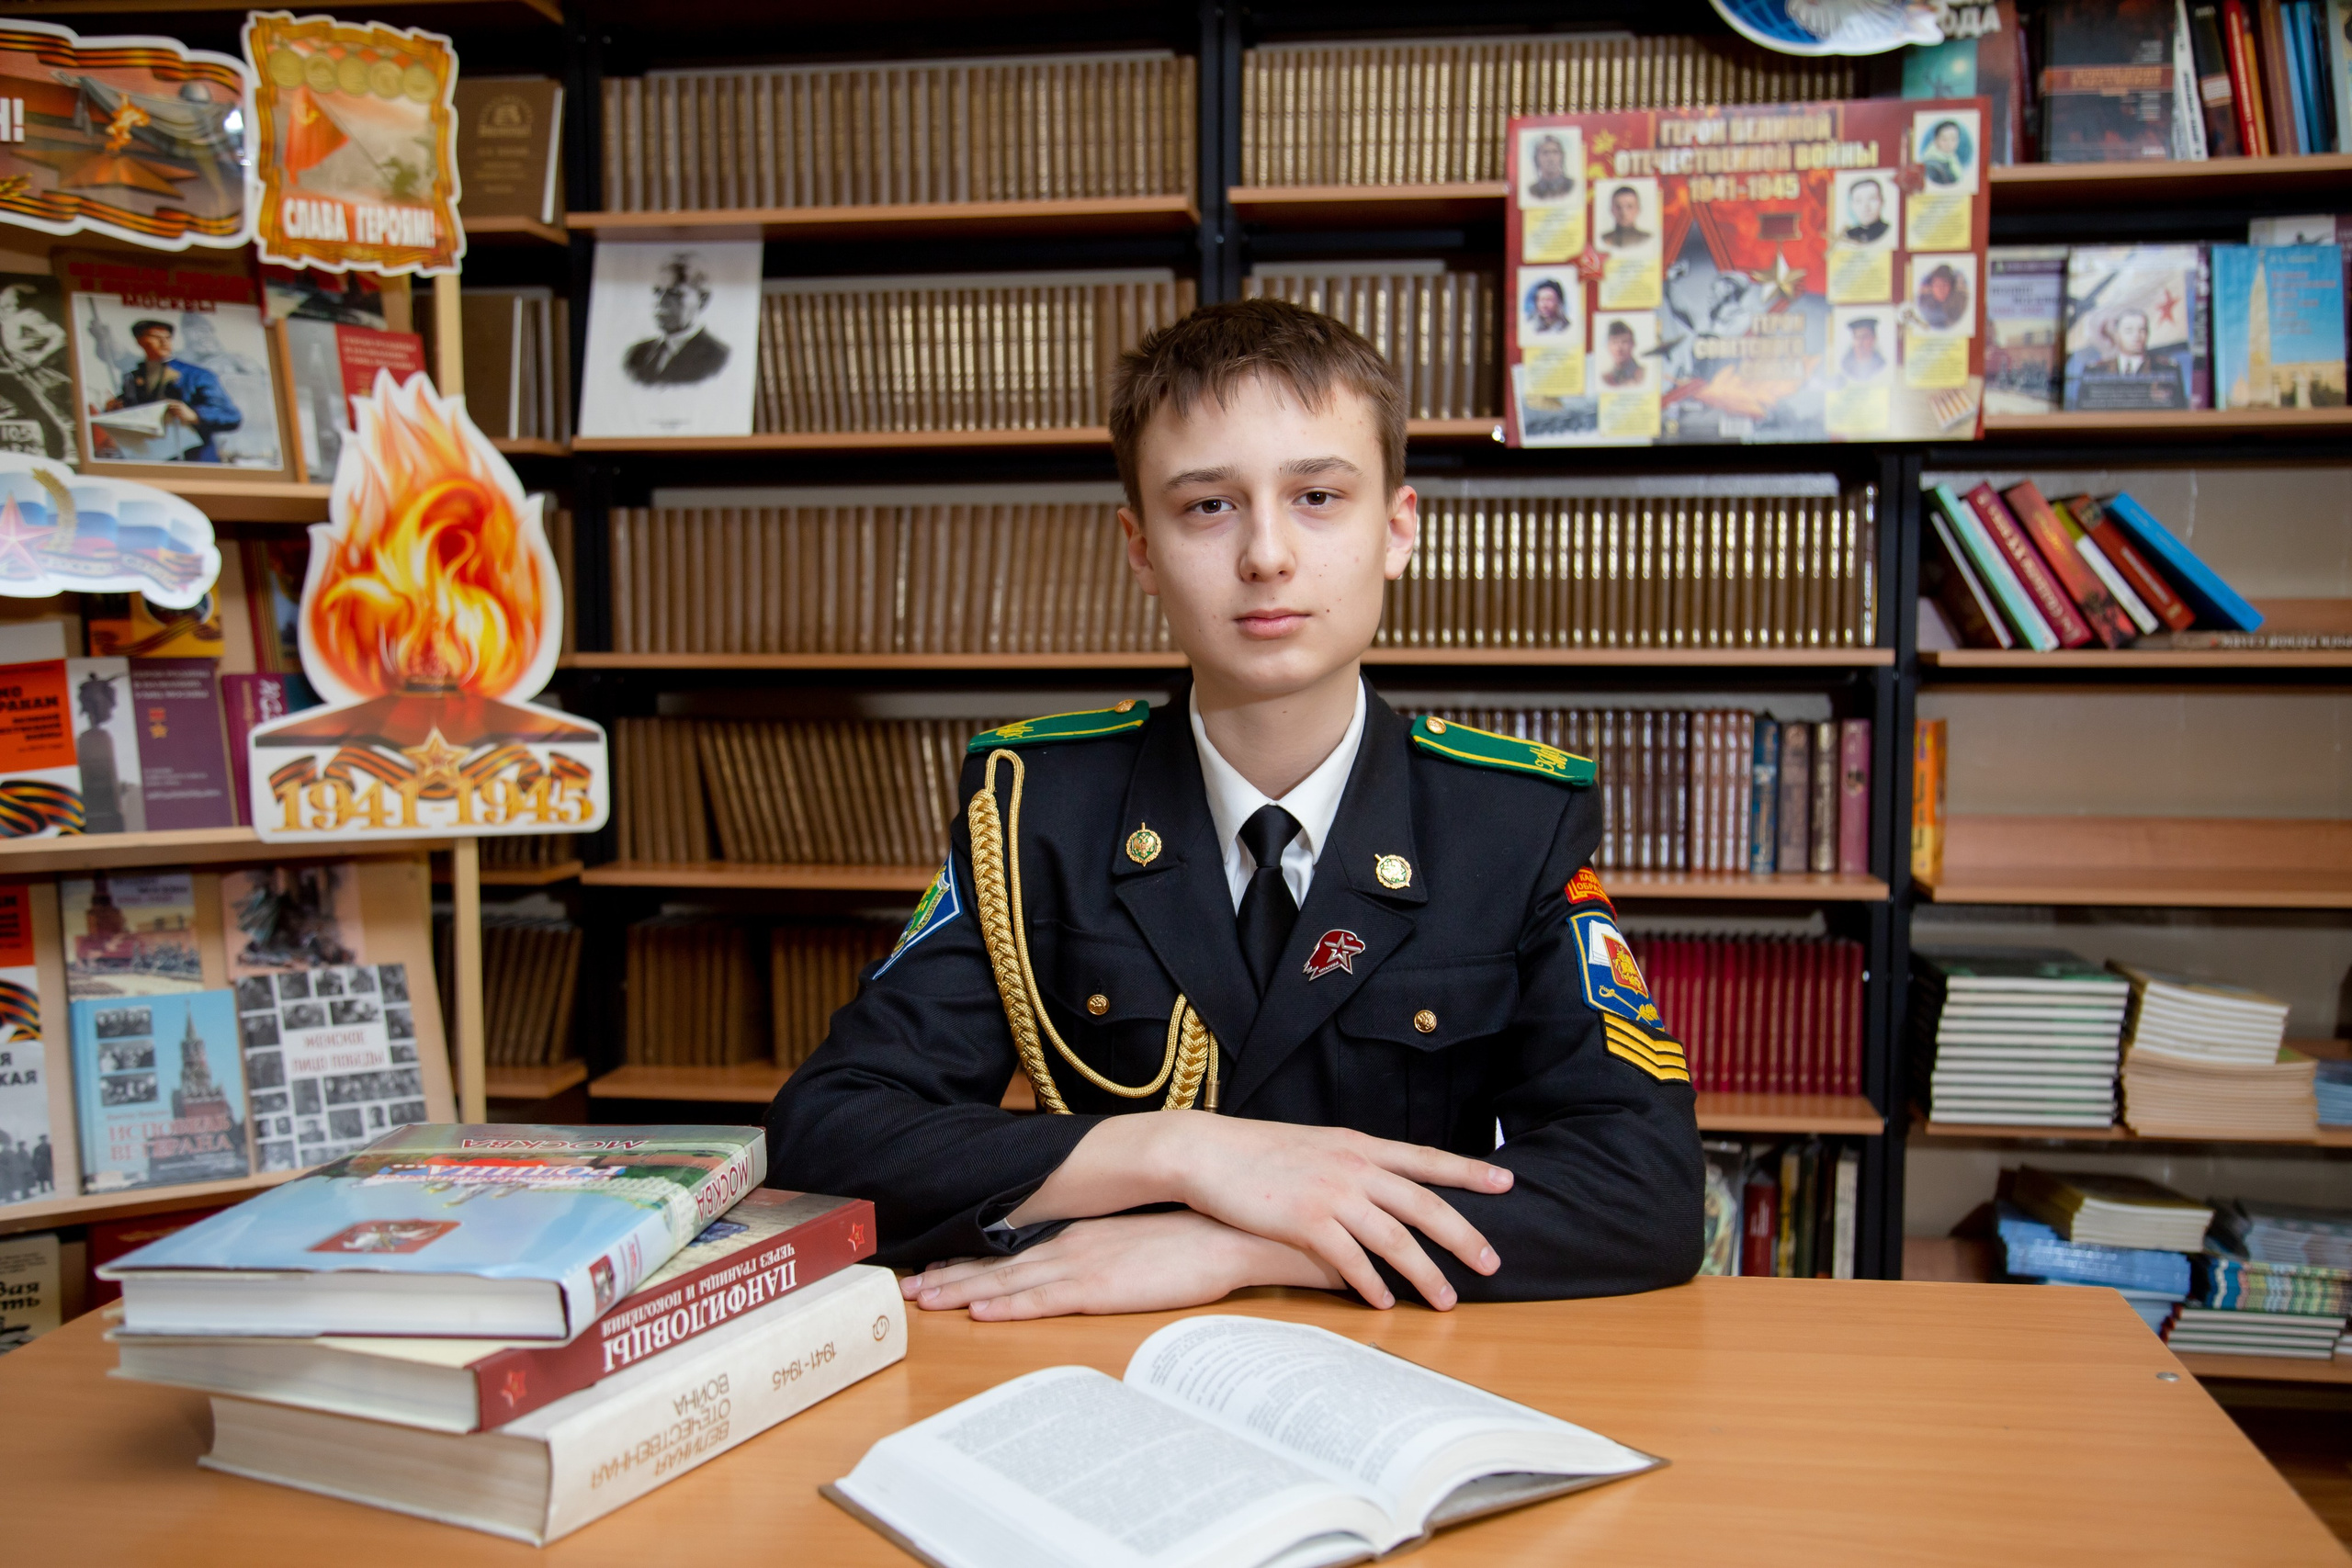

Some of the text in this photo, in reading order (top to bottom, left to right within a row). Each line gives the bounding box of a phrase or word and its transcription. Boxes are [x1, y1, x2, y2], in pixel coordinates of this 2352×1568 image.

[1660, 113, 1832, 146] ГЕРОИ ВЕЛИКОЙ
[1614, 140, 1880, 176] ОТЕЧЕСТВЕННОЙ ВОЙНЫ
[1689, 173, 1801, 202] 1941-1945
[282, 197, 436, 248] СЛАВА ГЕРОЯМ!
[270, 778, 594, 830] 1941-1945
[331, 1050, 385, 1068] ПОБЕДЫ
[107, 1112, 232, 1143] ИСПОВЕДЬ
[109, 1133, 235, 1161] ВЕТЕРАНА
[460, 1139, 650, 1151] МОСКВА
[694, 1153, 750, 1224] МОСКВА
[601, 1242, 796, 1338] ЧЕРЕЗ ГРАНИЦЫ И ПОКОЛЕНИЯ
[601, 1259, 797, 1374] ПАНФИЛОВЦЫ
[772, 1340, 837, 1393] 1941-1945
[673, 1372, 730, 1417] ВОЙНА
[590, 1397, 731, 1491] ОТЕЧЕСТВЕННАЯ
[653, 1419, 730, 1477] ВЕЛИКАЯ
